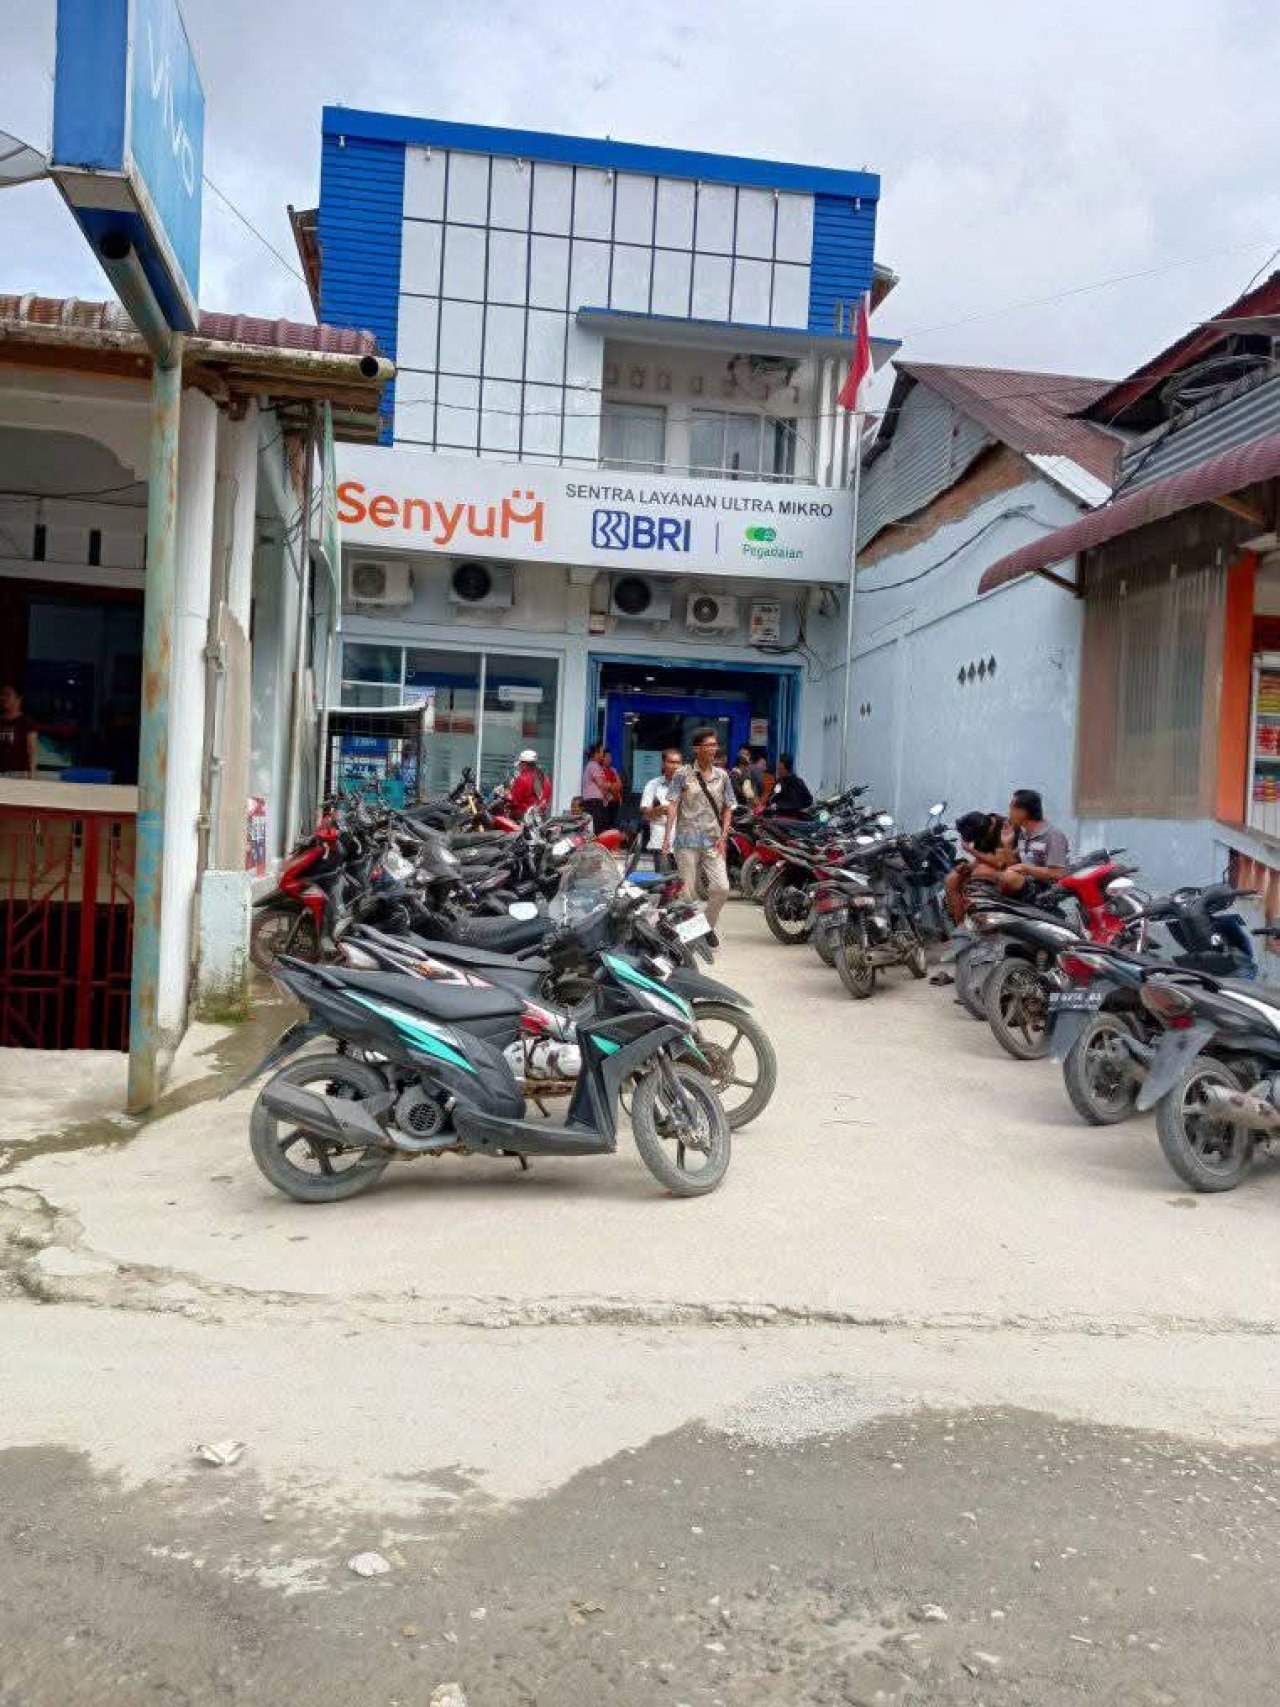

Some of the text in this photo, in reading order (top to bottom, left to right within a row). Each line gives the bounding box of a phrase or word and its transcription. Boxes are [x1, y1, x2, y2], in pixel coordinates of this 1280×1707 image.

[565, 483, 833, 517] SENTRA LAYANAN ULTRA MIKRO
[632, 515, 692, 551] BRI
[742, 544, 804, 560] Pegadaian
